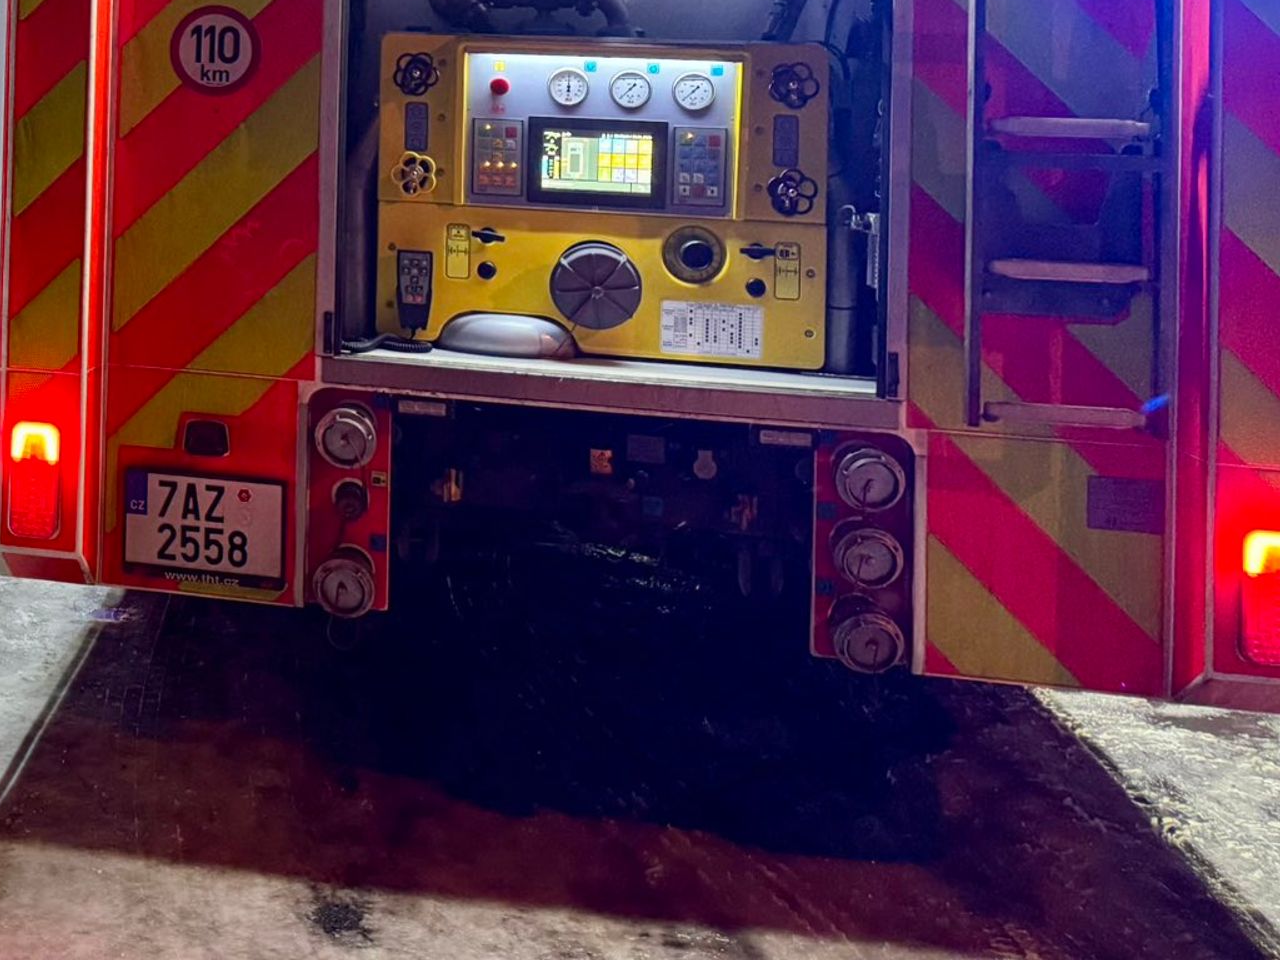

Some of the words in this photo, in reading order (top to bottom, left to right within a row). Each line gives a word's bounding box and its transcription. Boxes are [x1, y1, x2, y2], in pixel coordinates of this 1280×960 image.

[190, 24, 240, 64] 110
[200, 64, 230, 82] km
[130, 498, 145, 511] CZ
[158, 480, 225, 523] 7AZ
[157, 523, 248, 568] 2558
[165, 570, 239, 586] www.tht.cz
